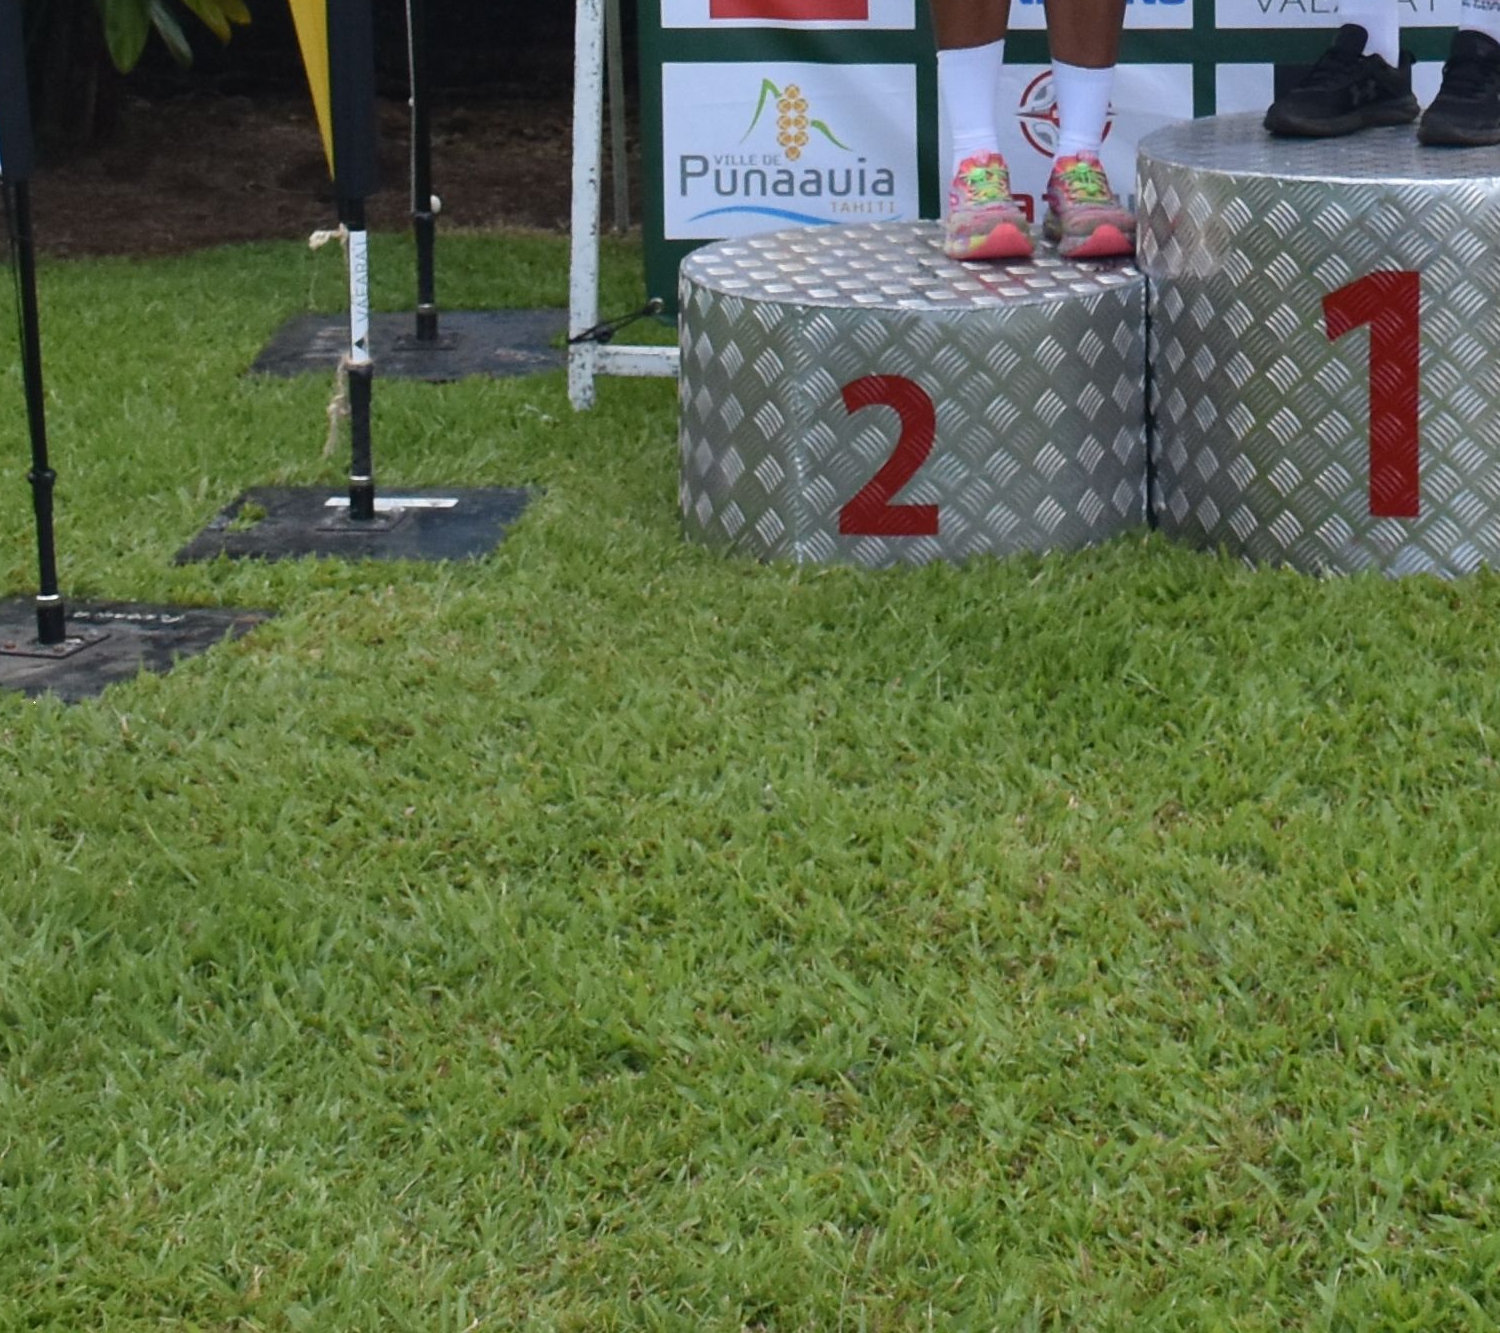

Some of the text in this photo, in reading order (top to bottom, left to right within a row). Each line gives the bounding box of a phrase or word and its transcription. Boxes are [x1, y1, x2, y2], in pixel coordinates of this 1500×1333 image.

[680, 154, 896, 198] Punaauia
[714, 154, 782, 167] VILLE DE
[830, 201, 897, 214] TAHITI
[1321, 270, 1421, 519] 1
[837, 373, 940, 535] 2
